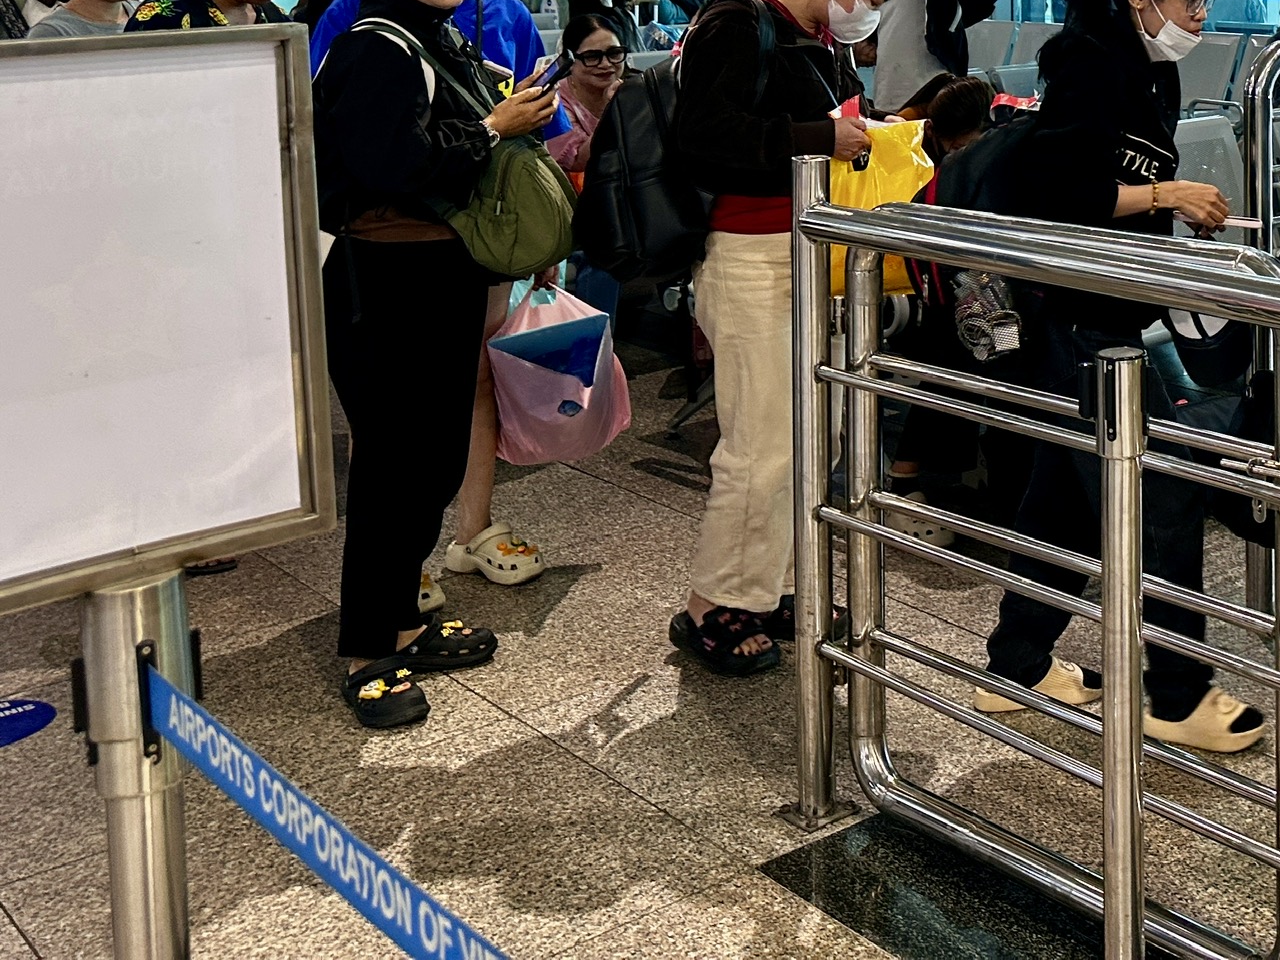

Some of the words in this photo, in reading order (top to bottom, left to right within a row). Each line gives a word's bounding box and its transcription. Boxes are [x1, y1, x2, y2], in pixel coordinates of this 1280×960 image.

[1118, 149, 1159, 179] TYLE
[169, 693, 255, 798] AIRPORTS
[259, 768, 412, 935] CORPORATION
[419, 900, 453, 960] OF
